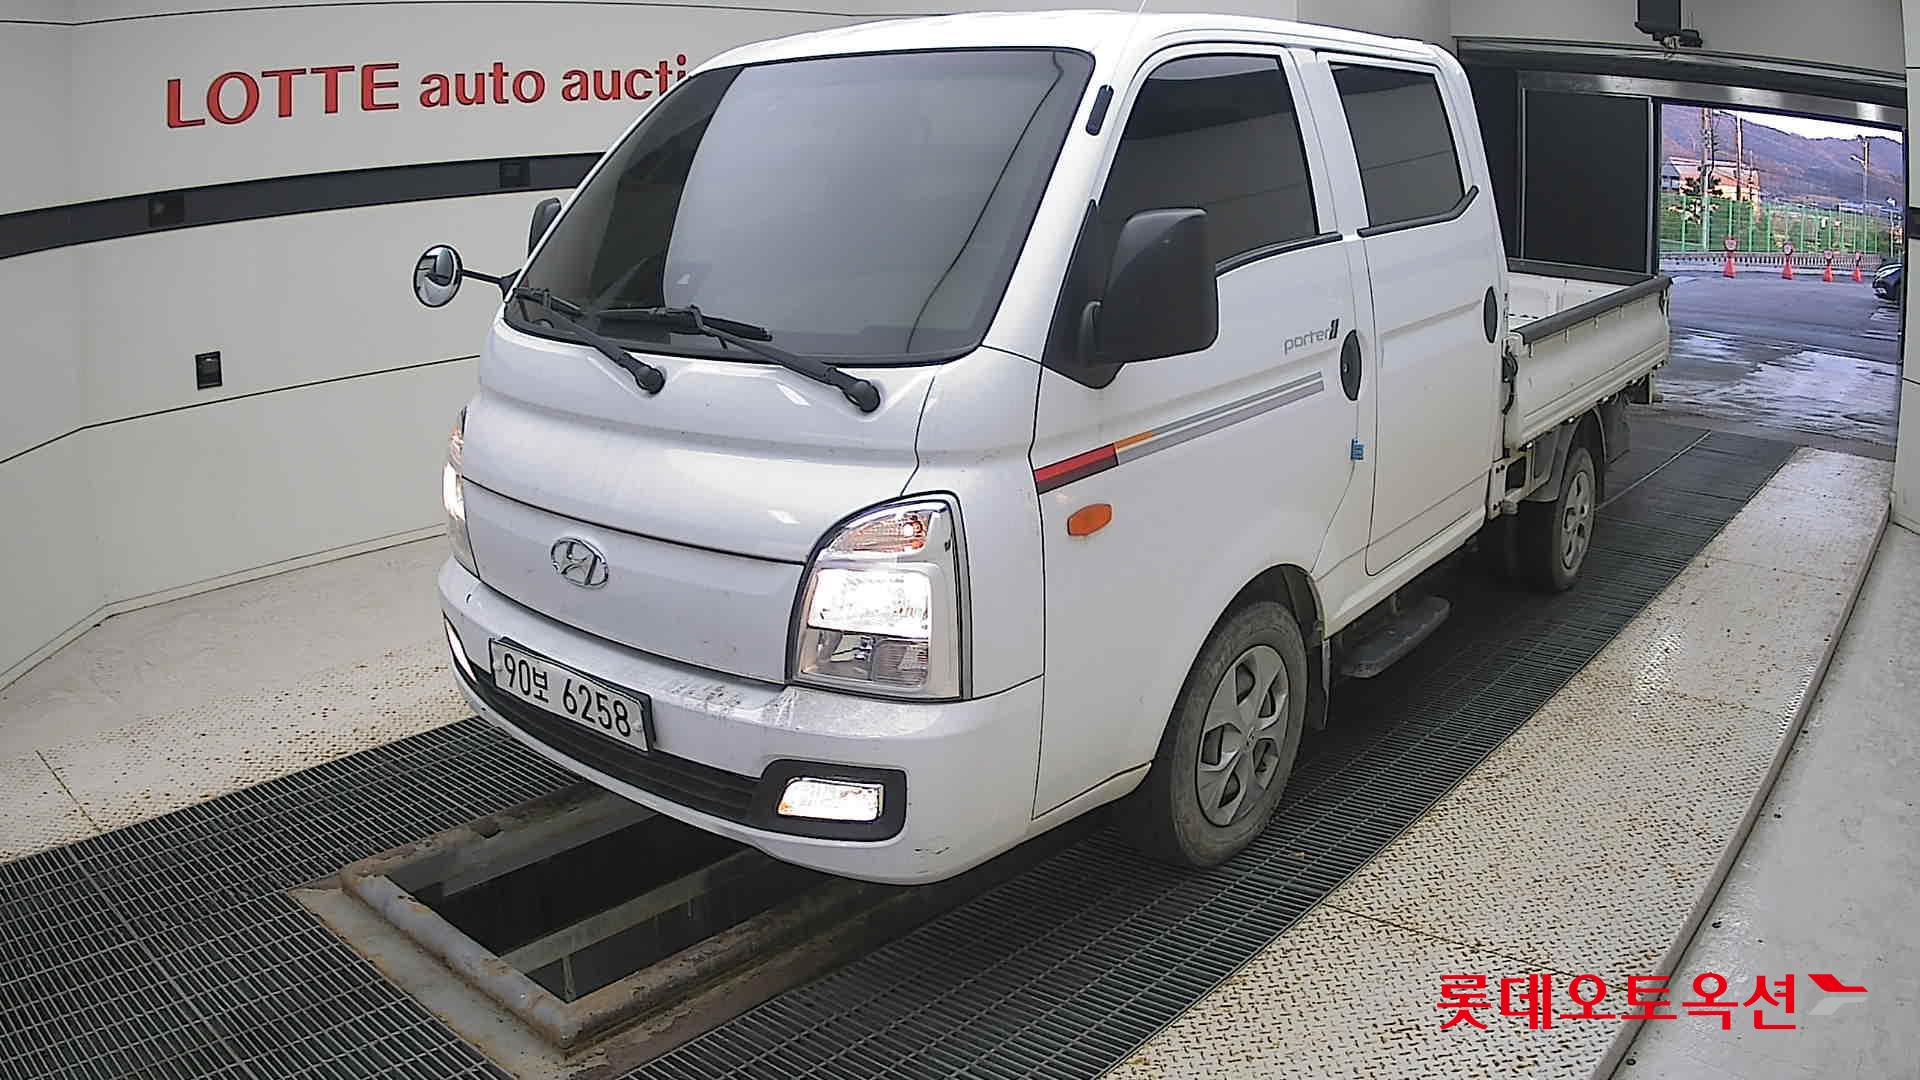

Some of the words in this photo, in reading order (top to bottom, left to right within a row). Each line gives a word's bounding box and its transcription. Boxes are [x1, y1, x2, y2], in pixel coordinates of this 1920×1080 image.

[167, 63, 399, 129] LOTTE
[419, 61, 546, 108] auto
[503, 652, 549, 703] 90보
[562, 678, 631, 737] 6258
